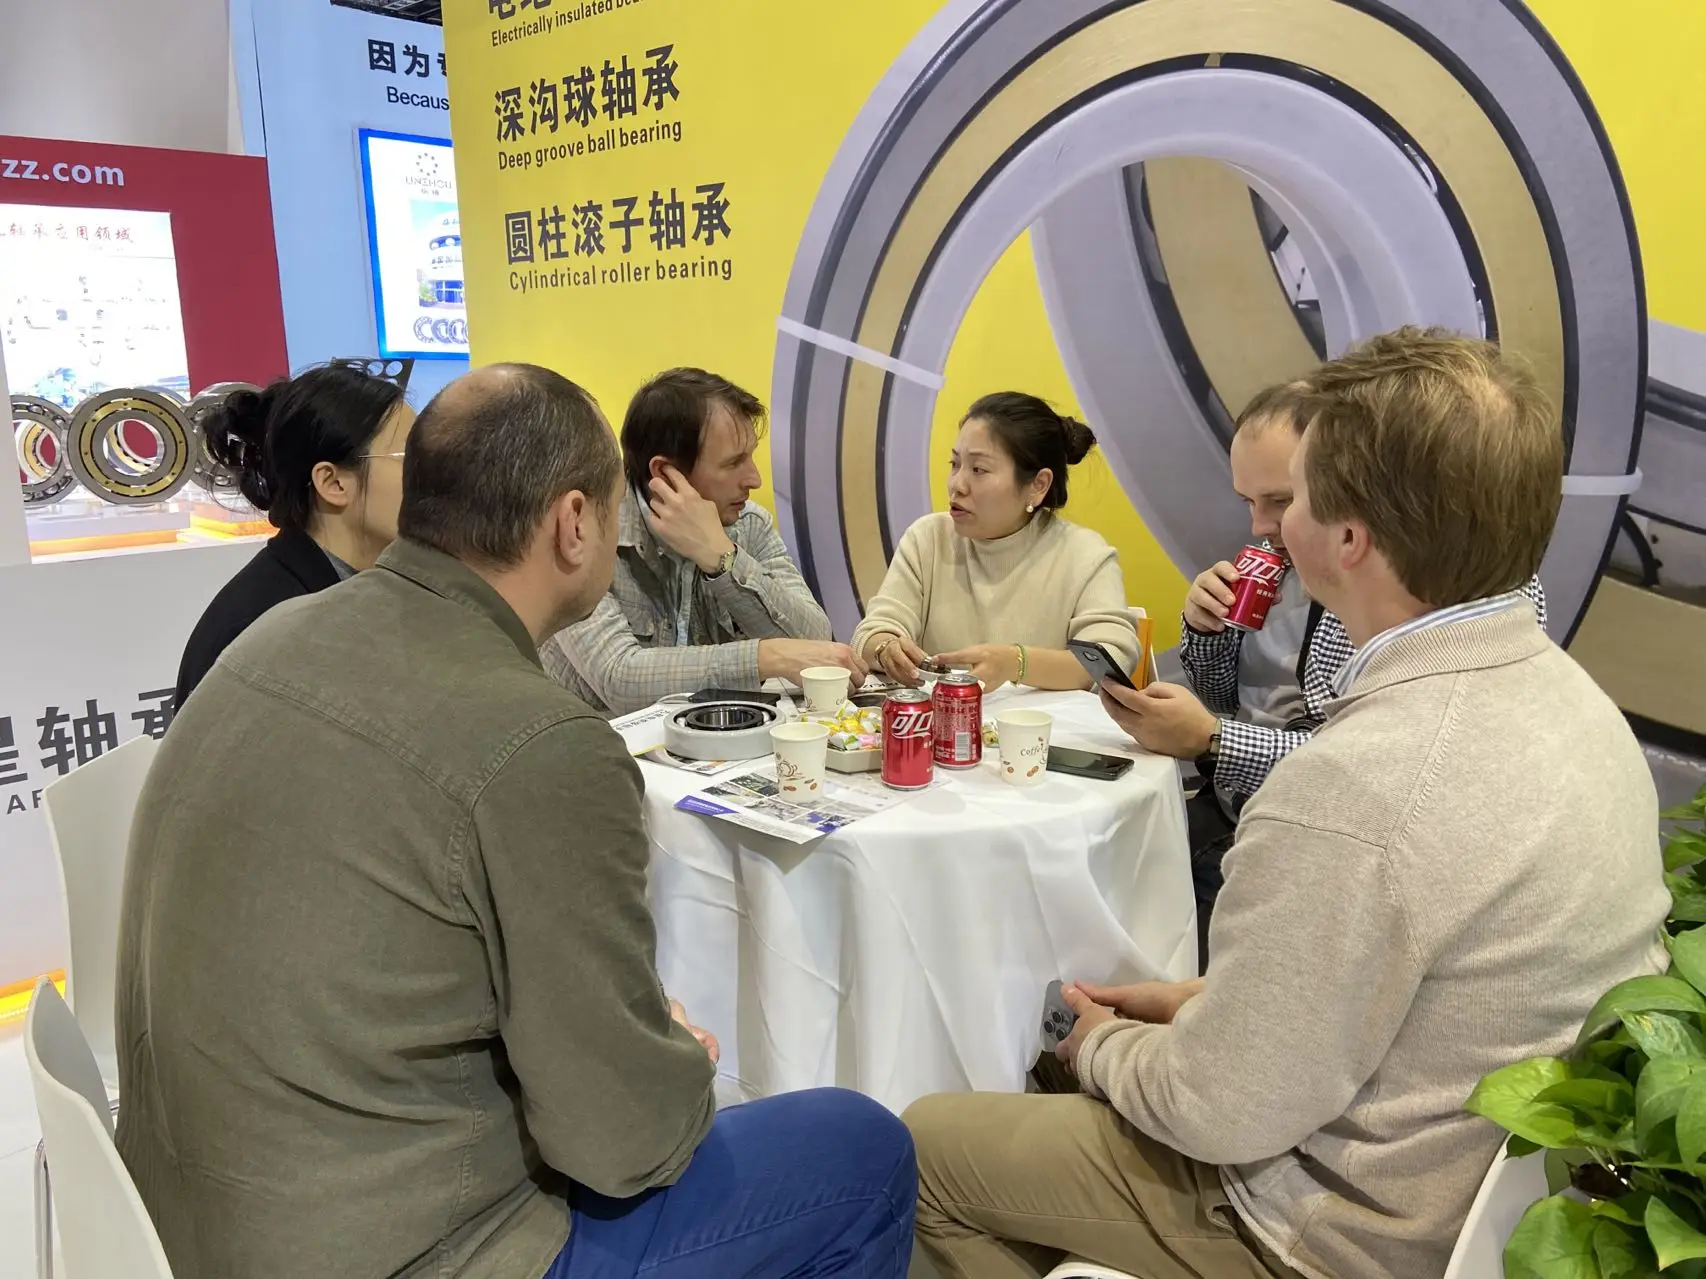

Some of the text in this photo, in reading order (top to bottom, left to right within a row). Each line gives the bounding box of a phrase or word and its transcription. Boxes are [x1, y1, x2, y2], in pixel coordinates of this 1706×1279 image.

[491, 14, 553, 47] Electrically
[555, 0, 613, 27] insulated
[386, 86, 450, 111] Becaus
[494, 43, 681, 143] 深沟球轴承
[498, 119, 683, 170] Deep groove ball bearing
[1, 158, 125, 186] zz.com
[0, 222, 134, 244] 轴承应用领域
[505, 182, 732, 265] 圆柱滚子轴承
[510, 255, 733, 294] Cylindrical roller bearing
